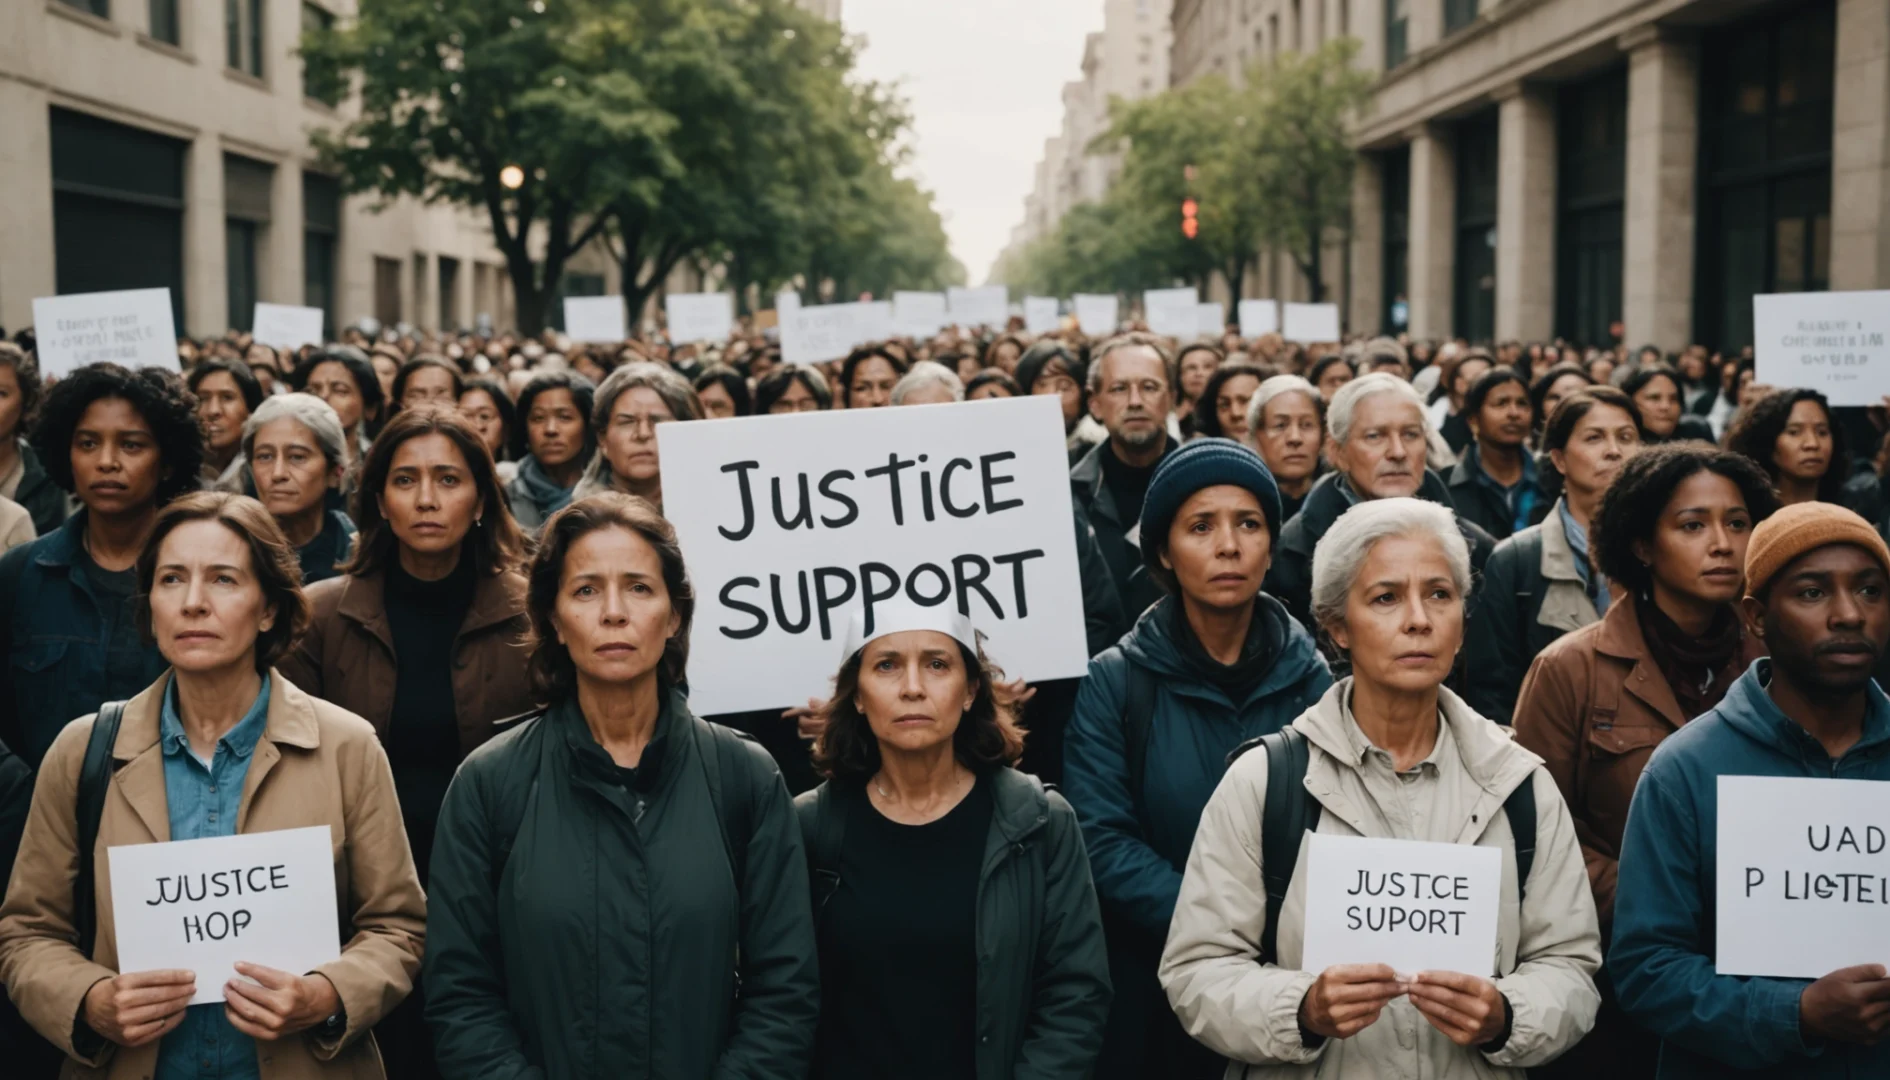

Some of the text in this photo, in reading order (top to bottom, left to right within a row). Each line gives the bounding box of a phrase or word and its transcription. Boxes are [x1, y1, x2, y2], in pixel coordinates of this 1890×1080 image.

[718, 548, 1045, 641] SUPPORT
[183, 909, 252, 944] HOP
[1346, 905, 1467, 936] SUPORT
